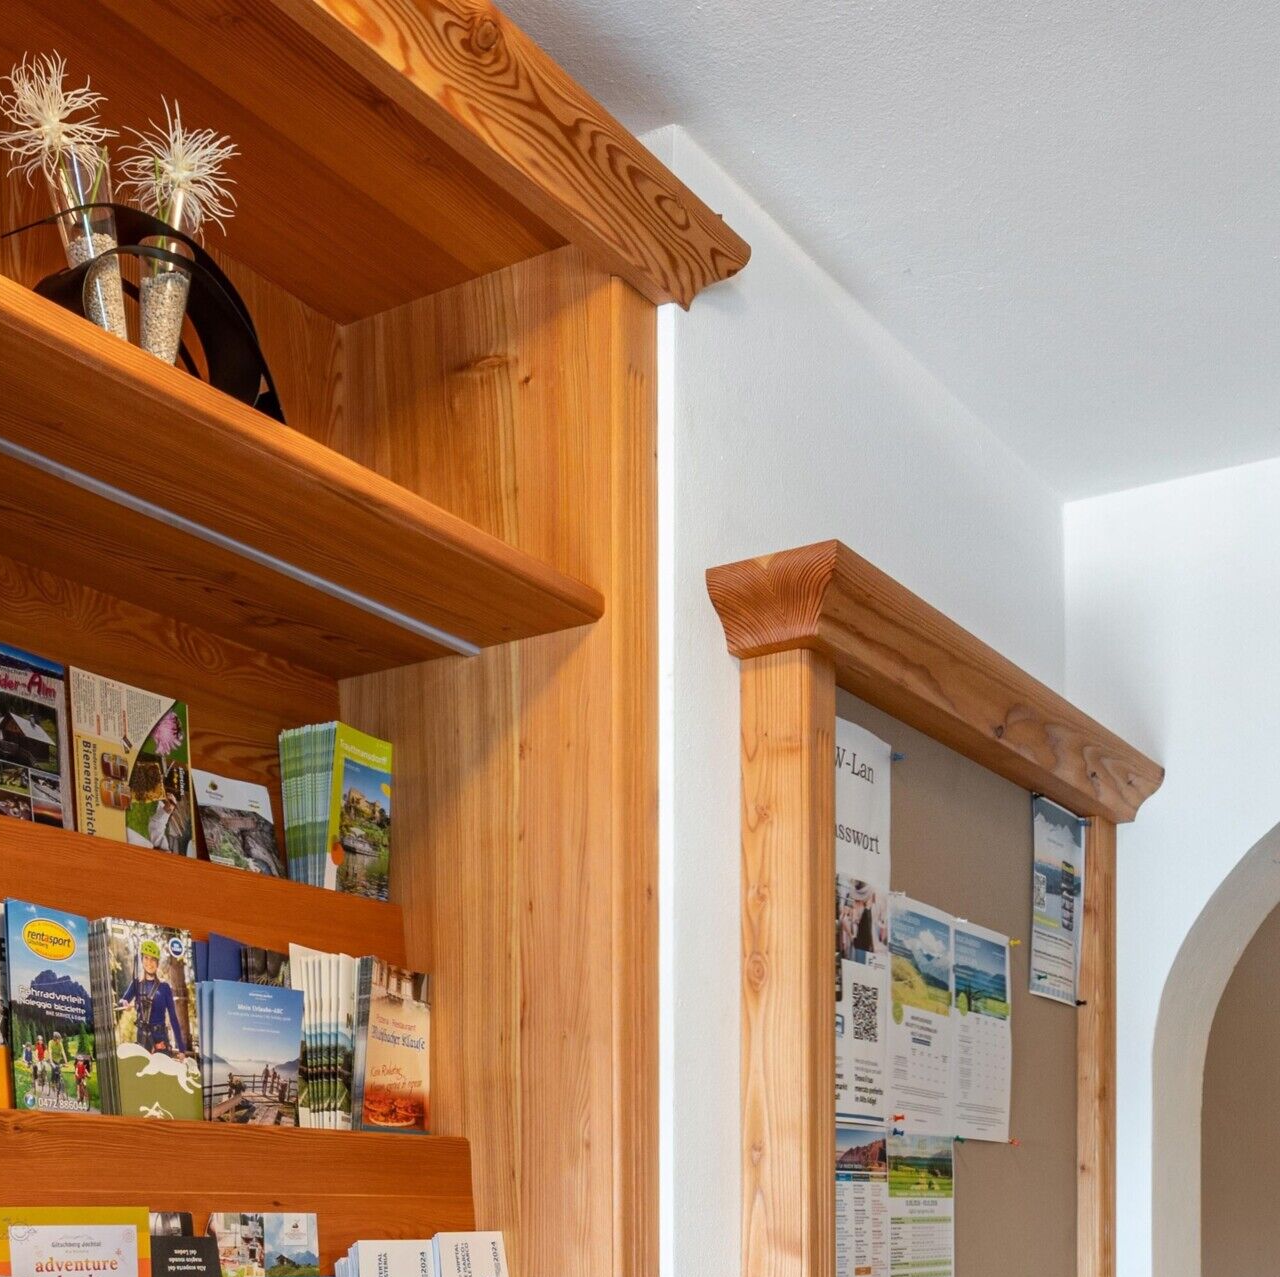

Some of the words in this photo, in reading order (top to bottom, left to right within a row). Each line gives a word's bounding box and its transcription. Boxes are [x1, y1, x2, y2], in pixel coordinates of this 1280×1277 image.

[835, 746, 874, 784] W-Lan
[27, 929, 72, 949] rentasport
[19, 984, 86, 1006] Fahrradverleih
[17, 996, 52, 1011] Noleggio
[53, 1001, 87, 1015] biciclette
[38, 1096, 59, 1108] 0472
[490, 1241, 499, 1262] 2024
[35, 1256, 118, 1273] adventure
[419, 1251, 427, 1274] 2024
